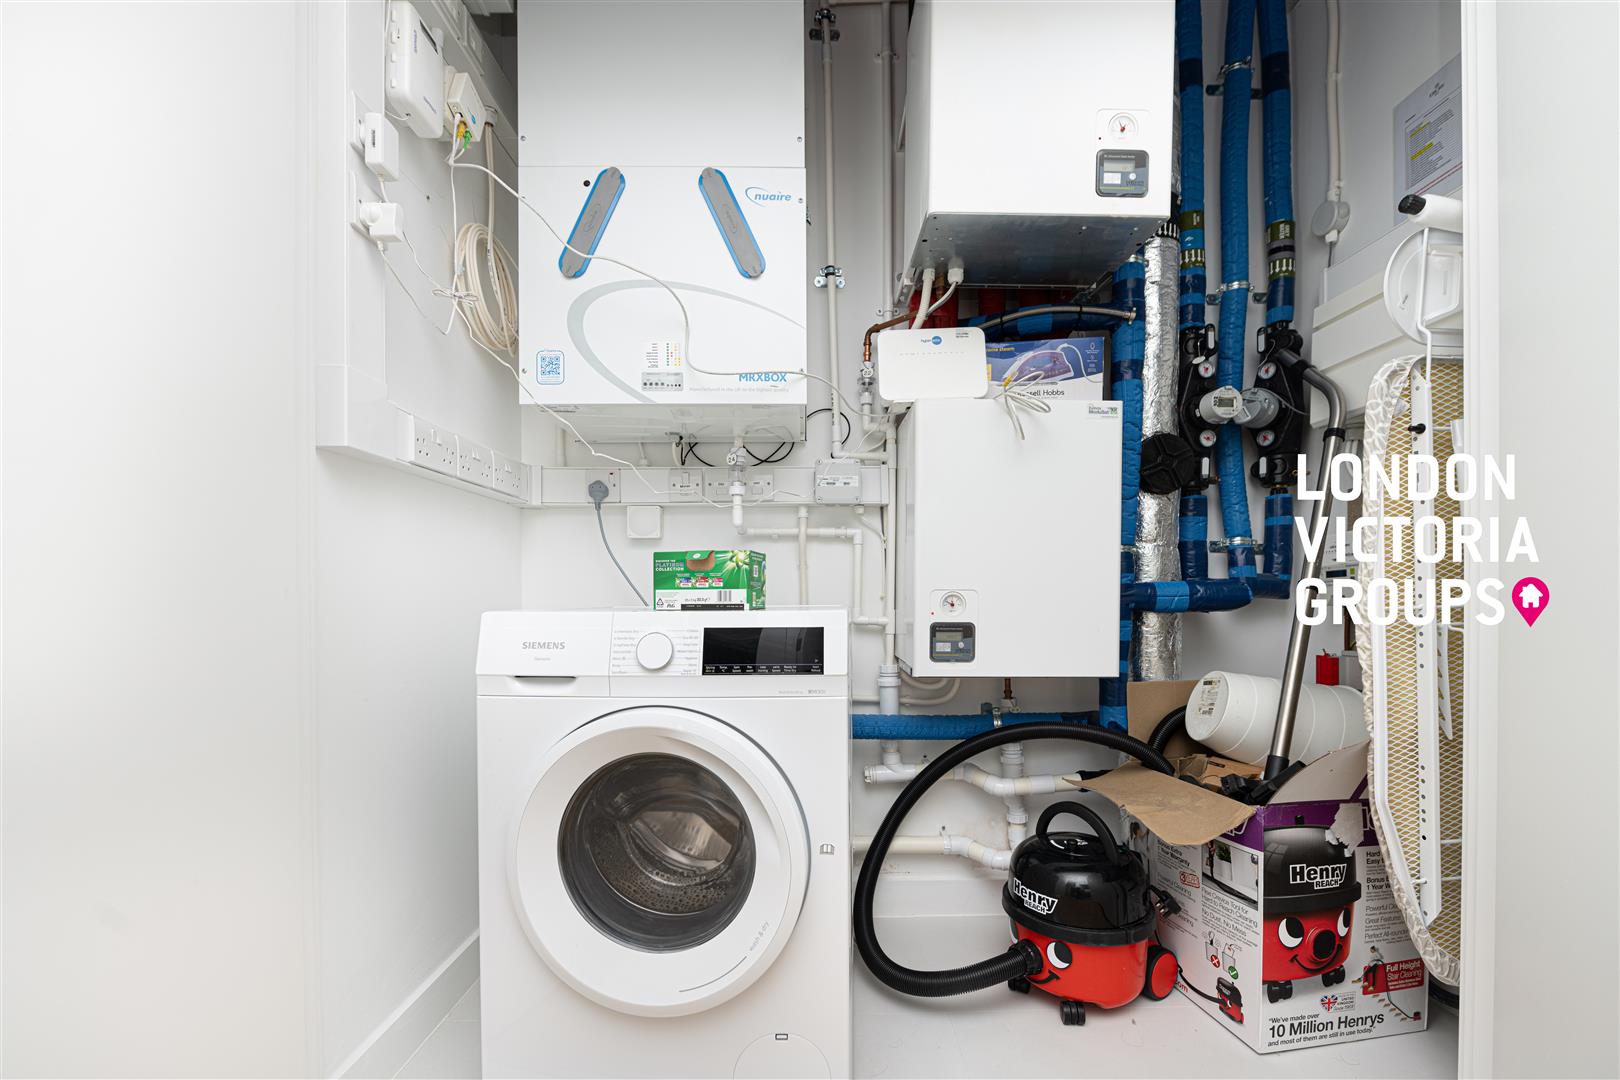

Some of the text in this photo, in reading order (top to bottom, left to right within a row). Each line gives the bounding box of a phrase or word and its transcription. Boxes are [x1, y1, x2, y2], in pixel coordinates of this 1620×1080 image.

[754, 192, 792, 201] nuaire
[738, 373, 787, 382] MRXBOX
[522, 641, 566, 650] SIEMENS
[1290, 864, 1347, 884] Henry
[1314, 879, 1339, 889] REACH
[1014, 878, 1058, 914] Henry
[1024, 899, 1046, 915] REACH
[1366, 904, 1388, 912] Powerful
[1386, 960, 1420, 972] Full Height
[1269, 1013, 1384, 1038] 10 Million Henrys
